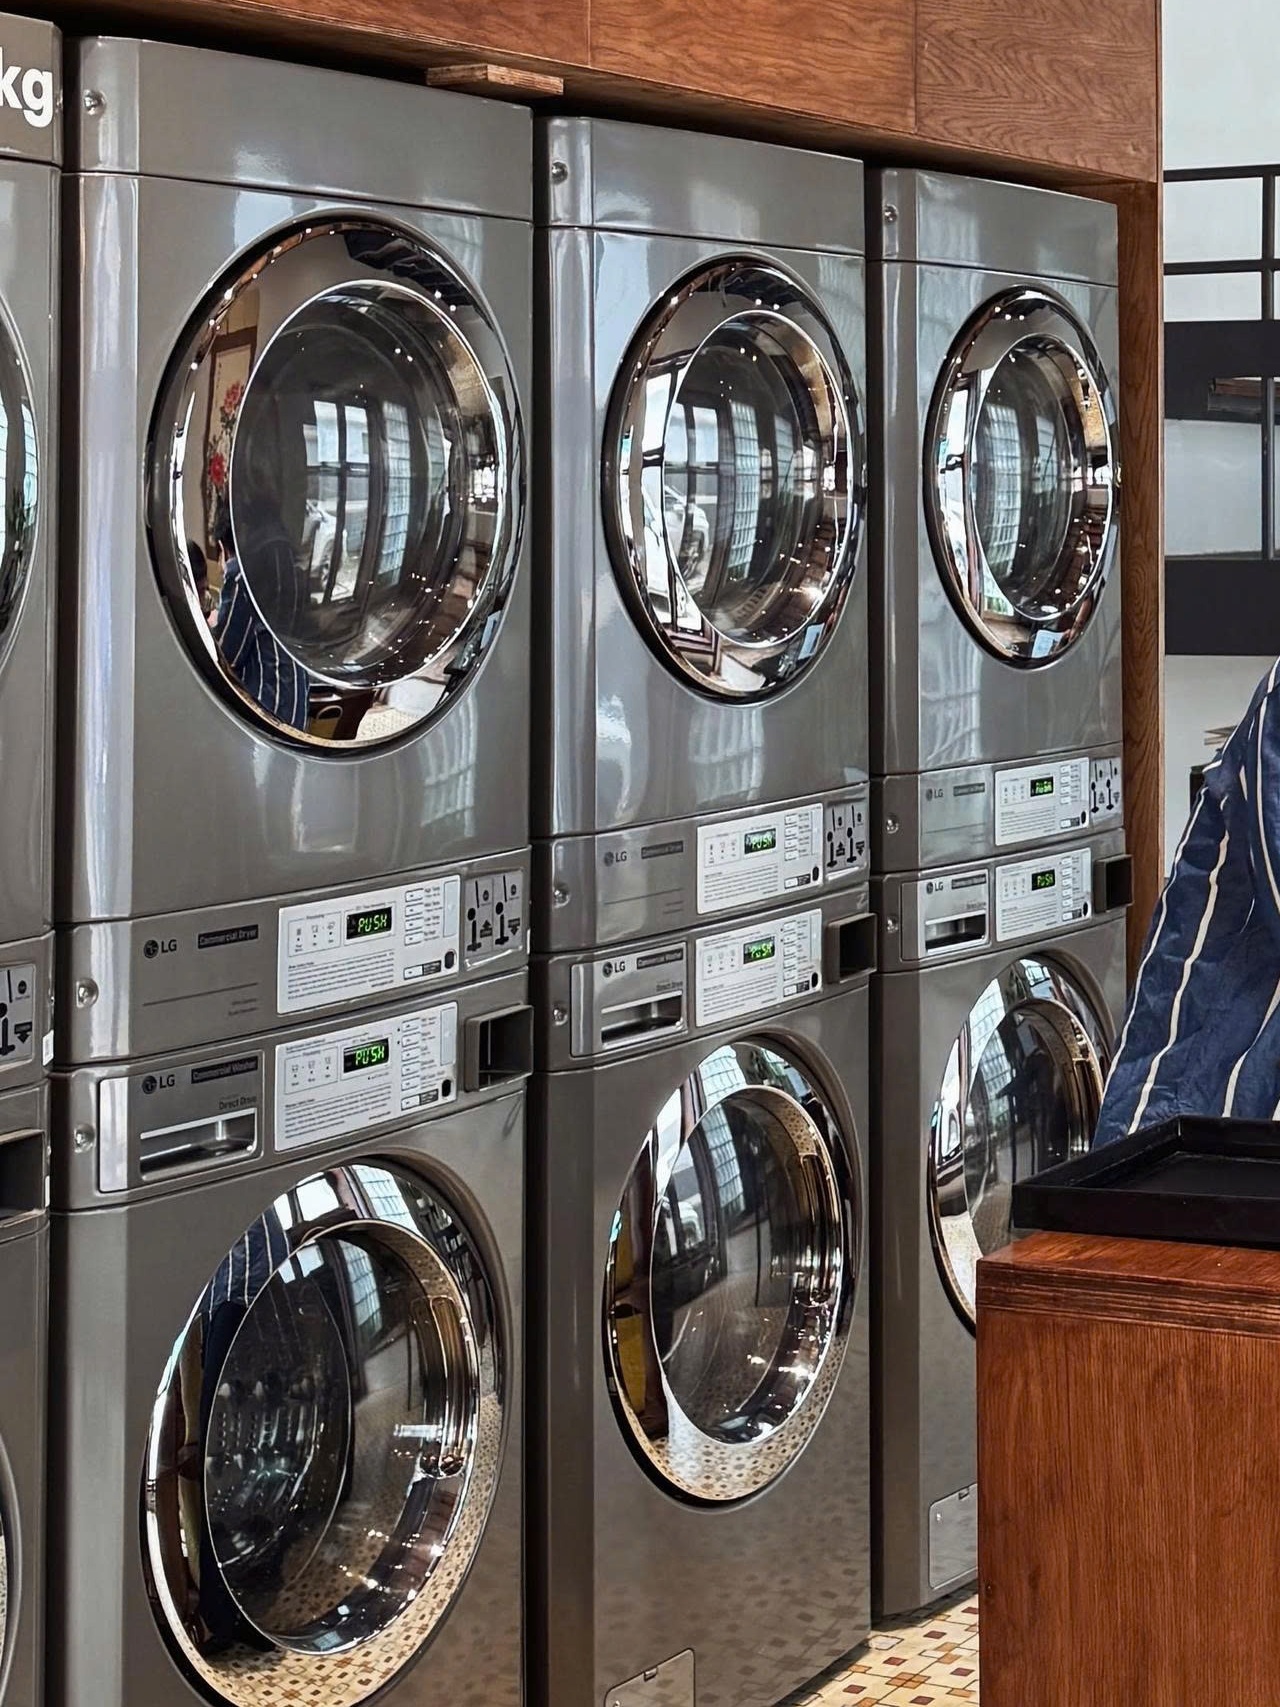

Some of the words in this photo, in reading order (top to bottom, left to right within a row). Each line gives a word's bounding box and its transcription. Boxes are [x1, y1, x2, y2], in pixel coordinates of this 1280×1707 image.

[0, 47, 53, 128] kg
[934, 789, 944, 799] LG
[751, 833, 773, 850] PUSH
[615, 851, 628, 863] LG
[934, 881, 944, 891] LG
[1036, 873, 1054, 886] PUSH
[357, 913, 389, 933] PUSH
[161, 939, 178, 953] LG
[750, 941, 773, 958] PUSH
[614, 961, 626, 973] LG
[355, 1045, 386, 1066] PUSH
[159, 1074, 176, 1088] LG
[219, 1099, 240, 1110] Direct
